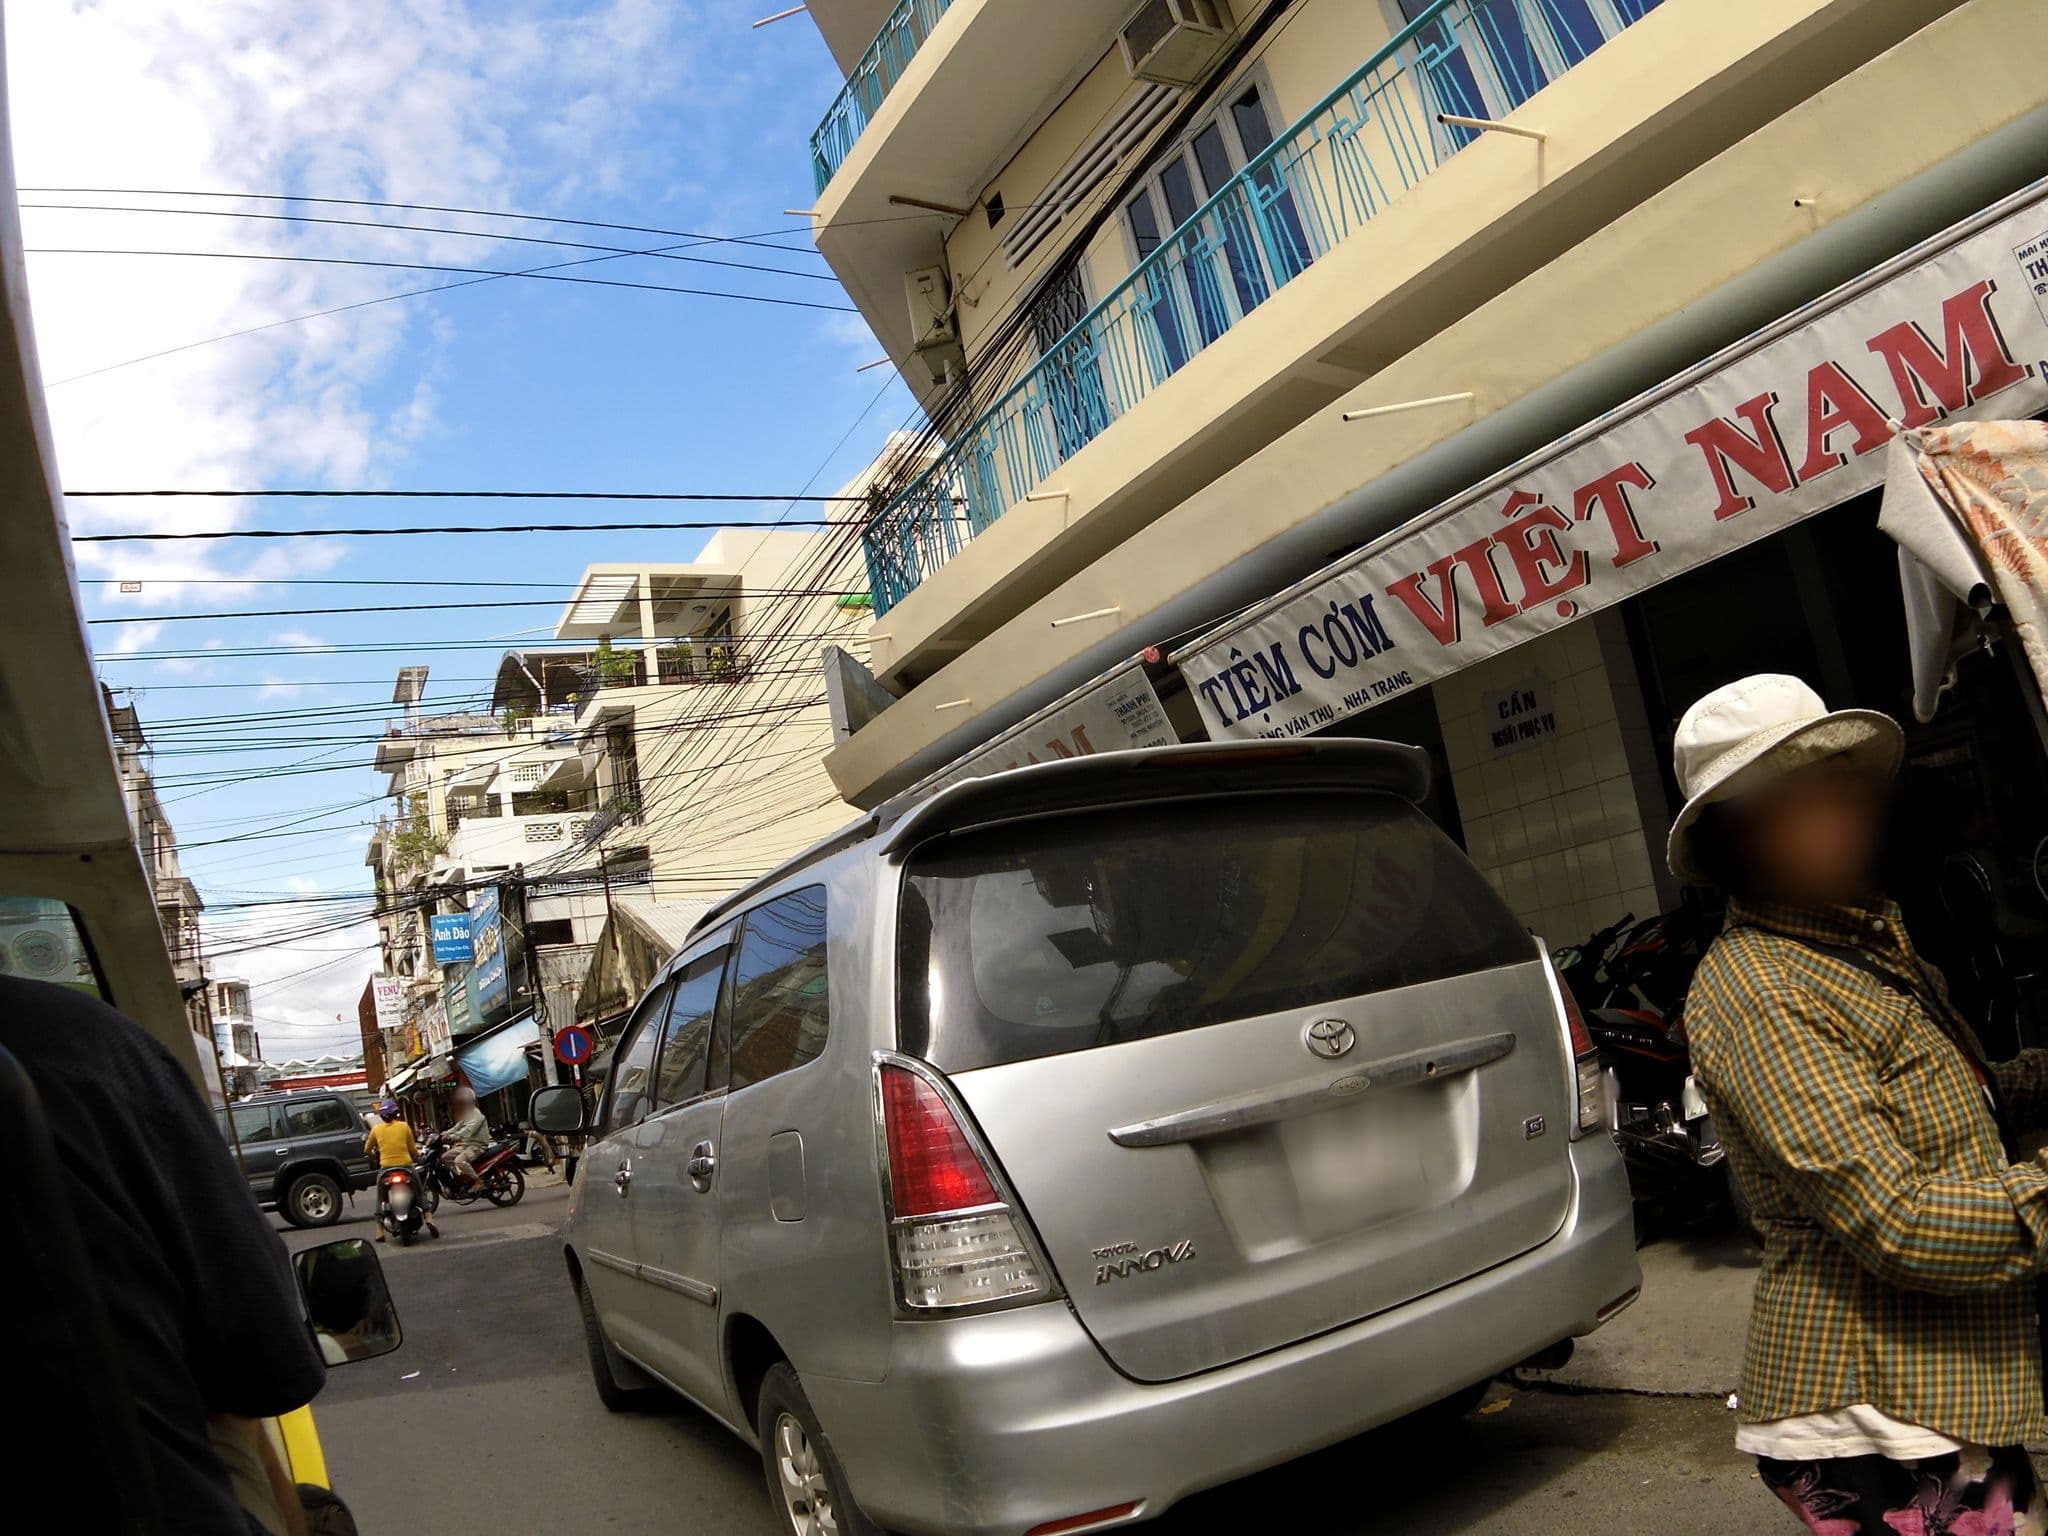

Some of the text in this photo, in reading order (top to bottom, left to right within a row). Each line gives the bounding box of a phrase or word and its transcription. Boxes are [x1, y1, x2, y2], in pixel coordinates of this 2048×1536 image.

[1198, 279, 2036, 728] TIỆM CƠM VIỆT NAM
[1284, 714, 1311, 735] VĂN
[1343, 689, 1371, 711] NHA
[1370, 670, 1413, 698] TRANG
[434, 927, 451, 941] Anh
[1091, 1240, 1139, 1261] TOYOTA
